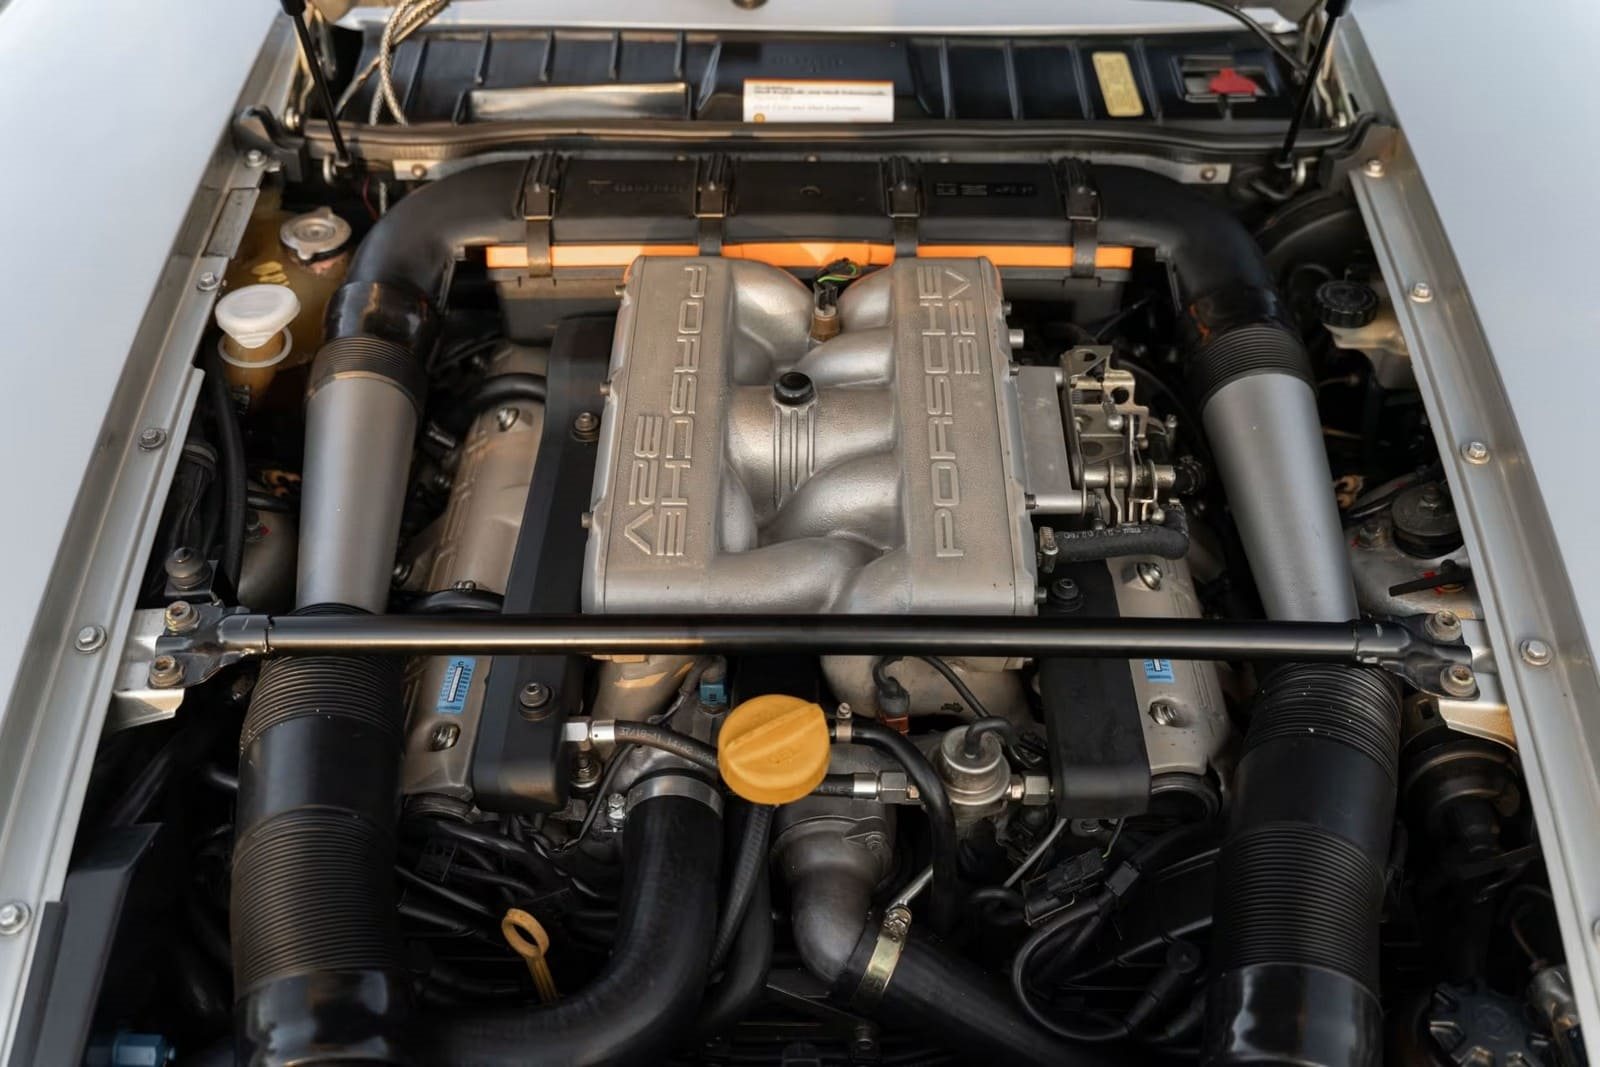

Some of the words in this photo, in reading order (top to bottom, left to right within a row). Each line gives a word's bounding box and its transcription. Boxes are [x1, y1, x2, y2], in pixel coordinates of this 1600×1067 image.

[658, 266, 707, 557] PORSCHE
[917, 265, 965, 557] PORSCHE
[946, 270, 981, 375] 32V
[624, 415, 663, 556] 32V
